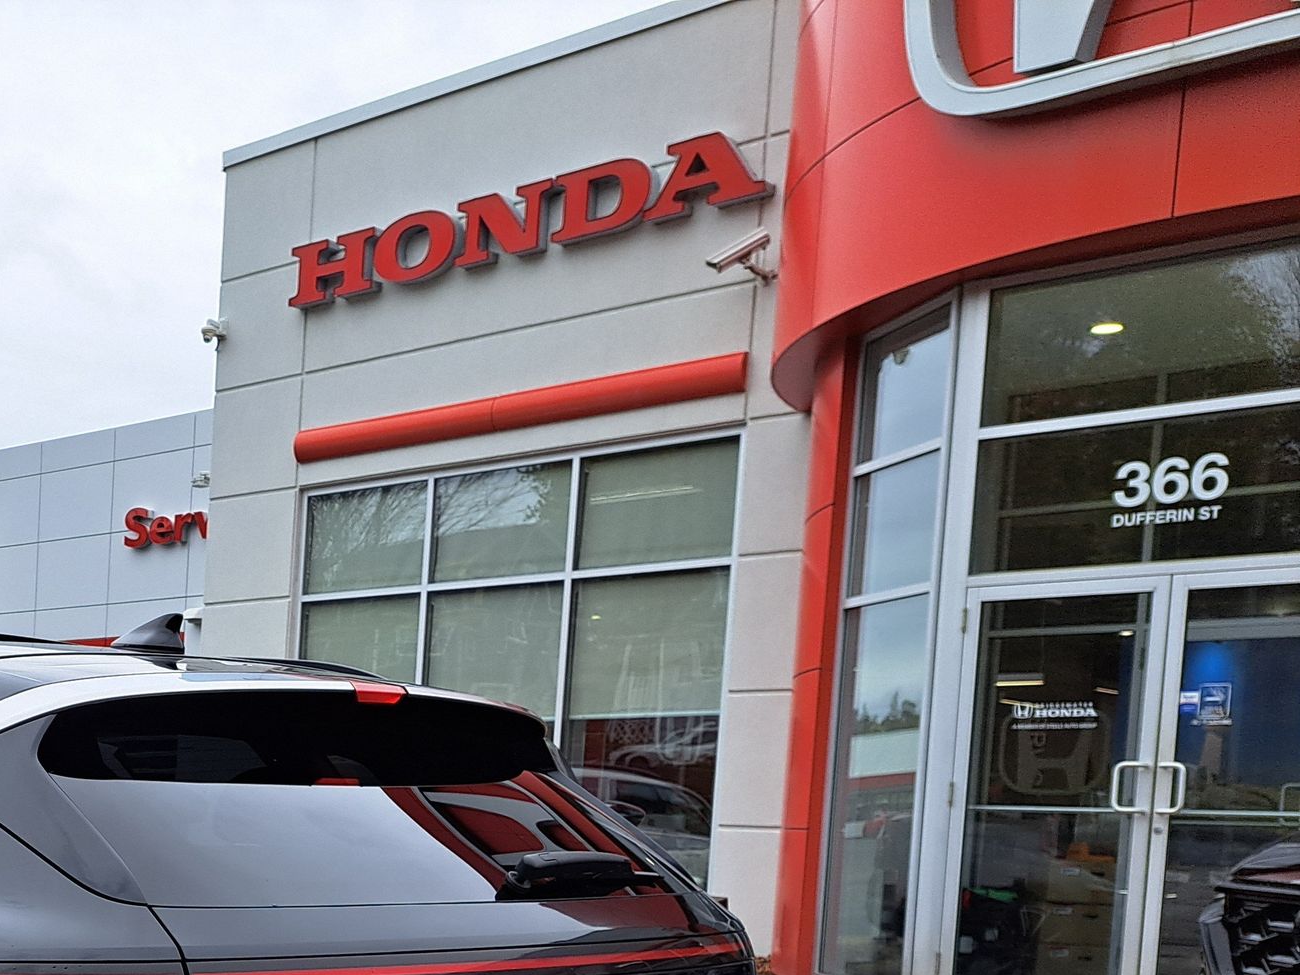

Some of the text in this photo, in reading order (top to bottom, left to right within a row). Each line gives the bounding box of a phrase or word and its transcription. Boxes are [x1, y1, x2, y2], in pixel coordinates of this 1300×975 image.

[288, 131, 774, 309] HONDA
[1113, 452, 1229, 507] 366
[124, 507, 208, 548] Serv
[1111, 505, 1222, 528] DUFFERIN ST
[1034, 707, 1099, 718] HONDA
